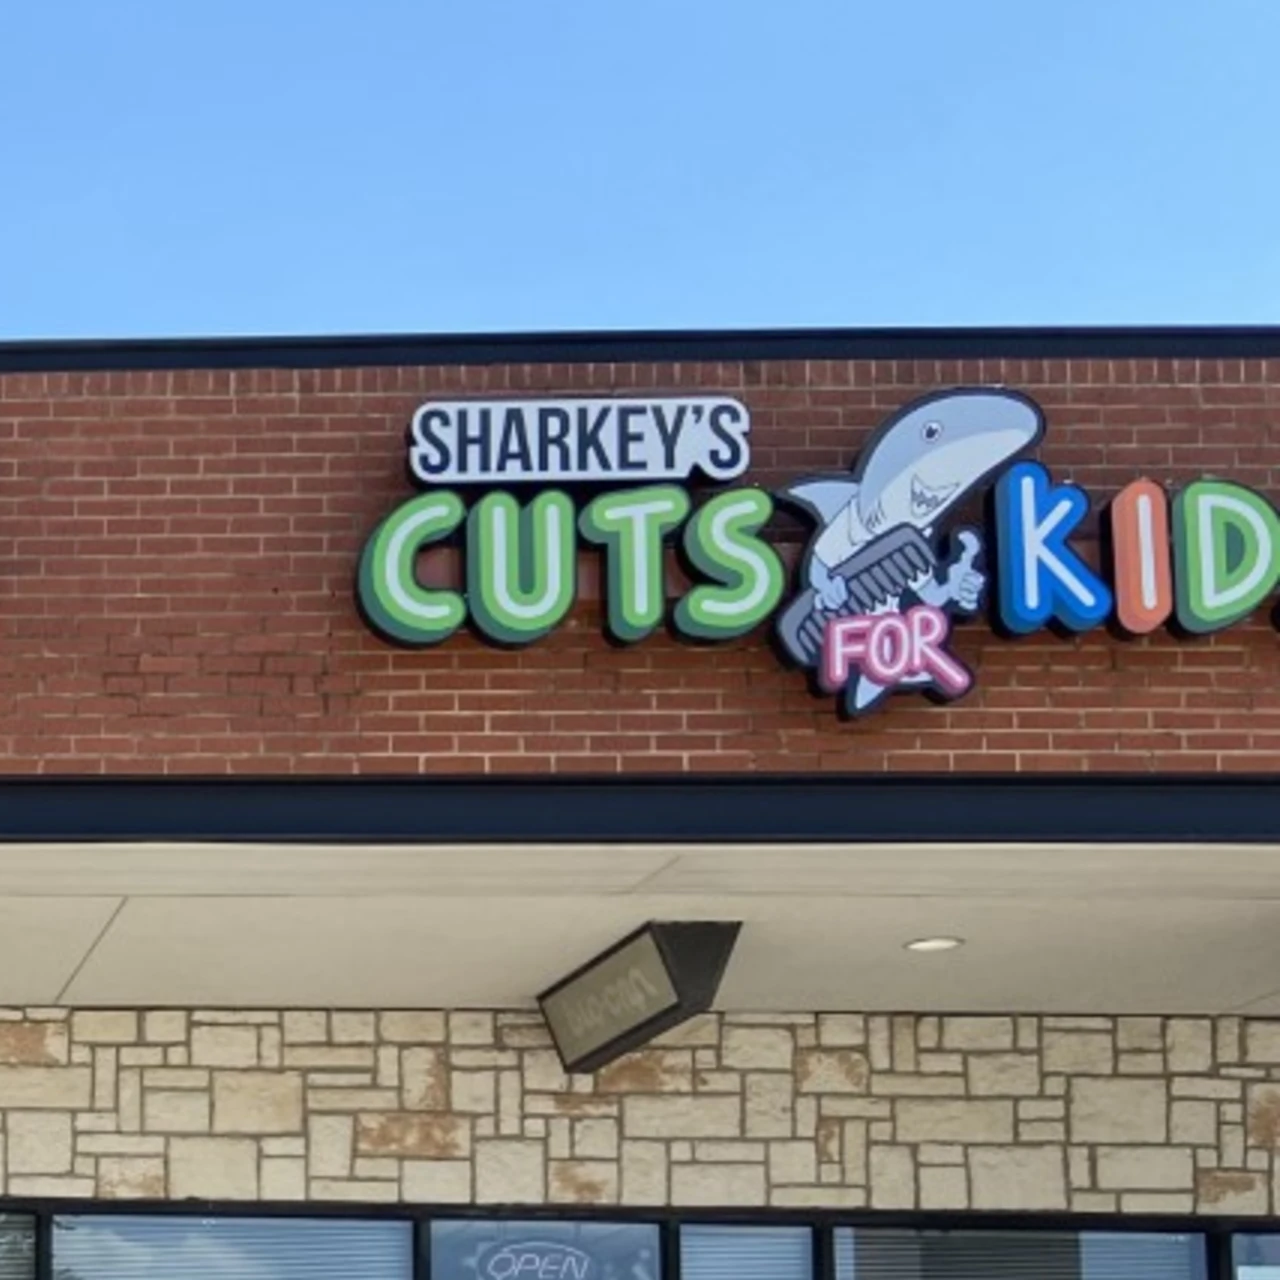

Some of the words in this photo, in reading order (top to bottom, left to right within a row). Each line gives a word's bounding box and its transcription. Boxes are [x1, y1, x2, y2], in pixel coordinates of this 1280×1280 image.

[418, 404, 742, 474] SHARKEY'S
[358, 486, 784, 645] CUTS
[820, 604, 972, 695] FOR
[490, 1253, 589, 1280] OPEN
